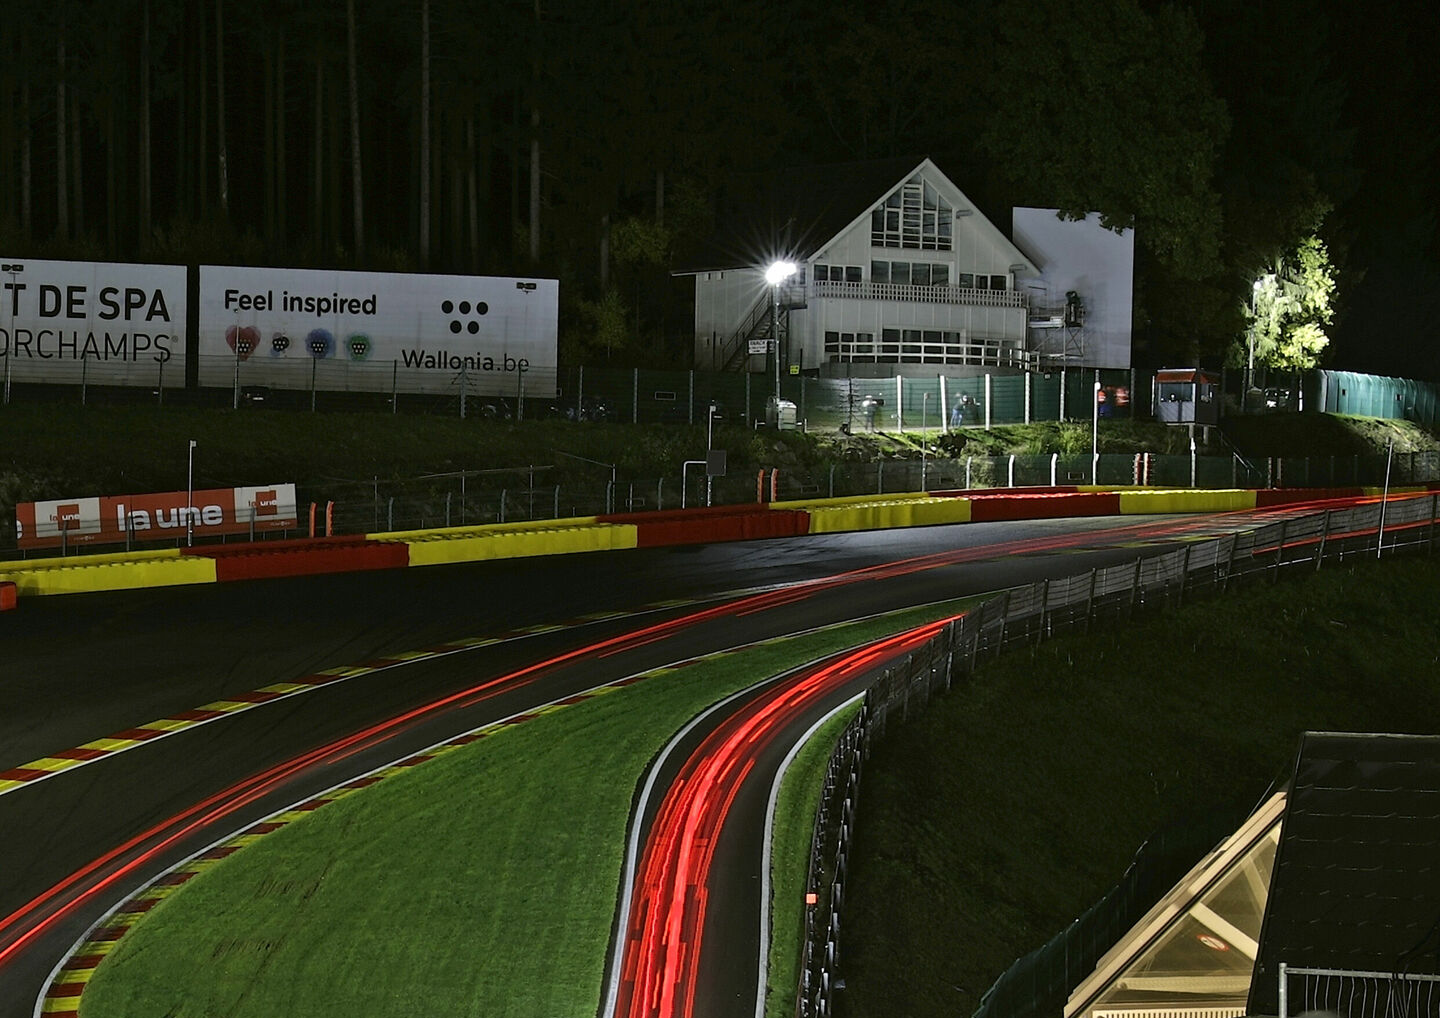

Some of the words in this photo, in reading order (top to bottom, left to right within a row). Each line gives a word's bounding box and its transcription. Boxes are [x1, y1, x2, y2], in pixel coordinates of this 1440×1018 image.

[39, 284, 87, 319] DE
[98, 287, 171, 322] SPA
[224, 289, 273, 312] Feel
[283, 291, 377, 317] inspired
[401, 350, 529, 373] Wallonia.be
[117, 503, 153, 532] la
[156, 504, 223, 529] une
